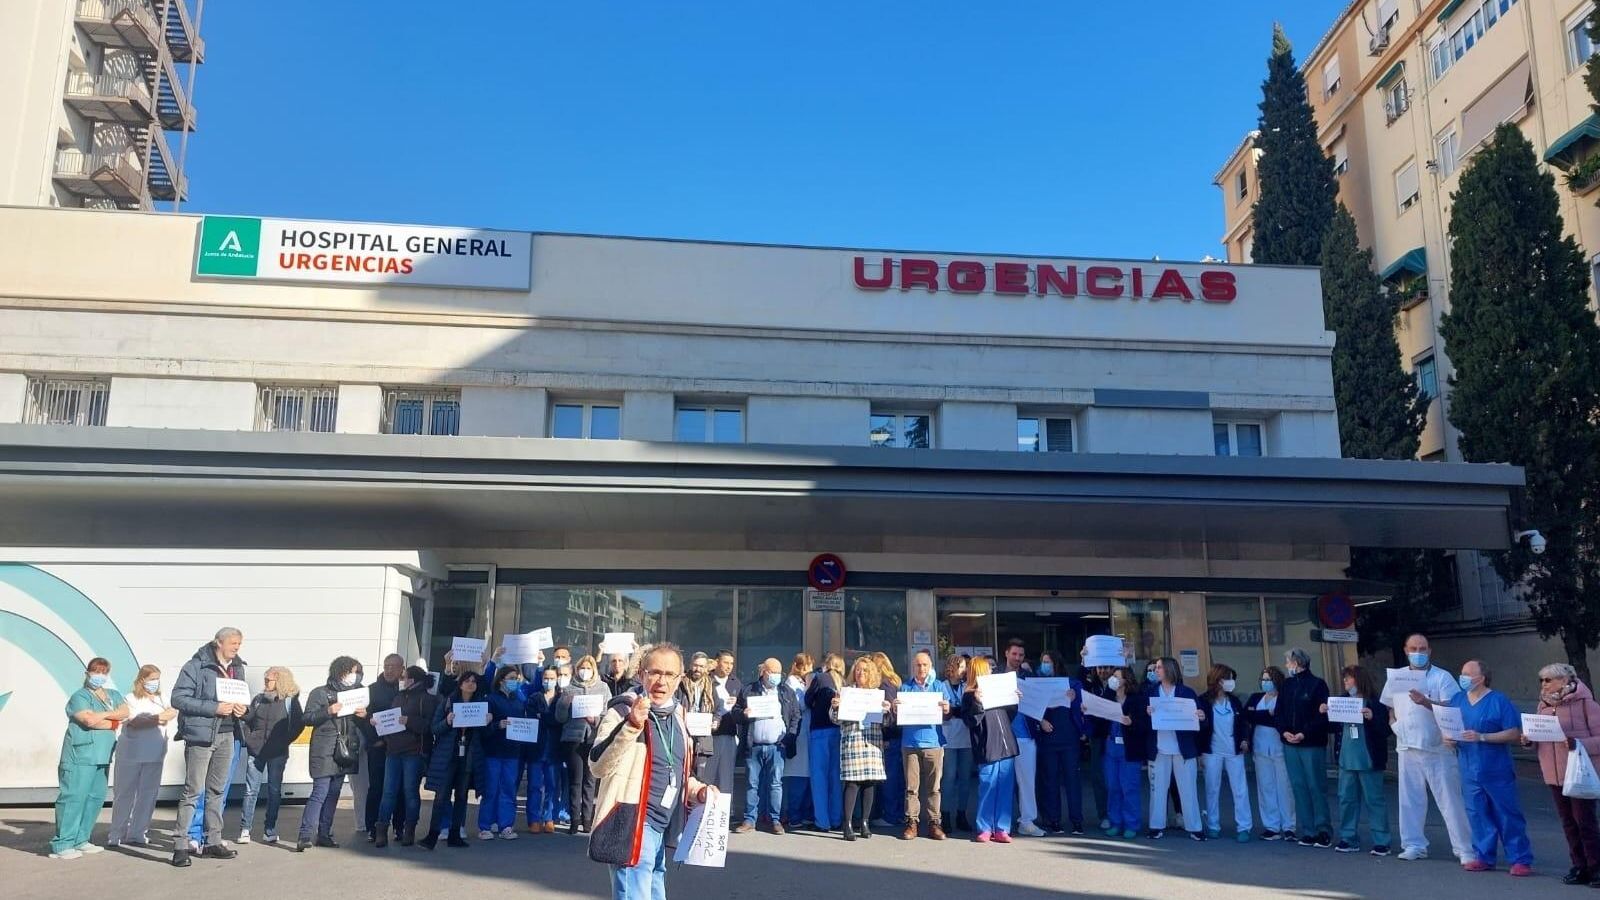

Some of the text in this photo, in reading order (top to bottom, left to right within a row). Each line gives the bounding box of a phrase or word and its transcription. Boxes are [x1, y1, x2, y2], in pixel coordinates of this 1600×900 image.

[281, 229, 512, 257] HOSPITAL GENERAL
[279, 253, 413, 274] URGENCIAS
[853, 257, 1237, 303] URGENCIAS
